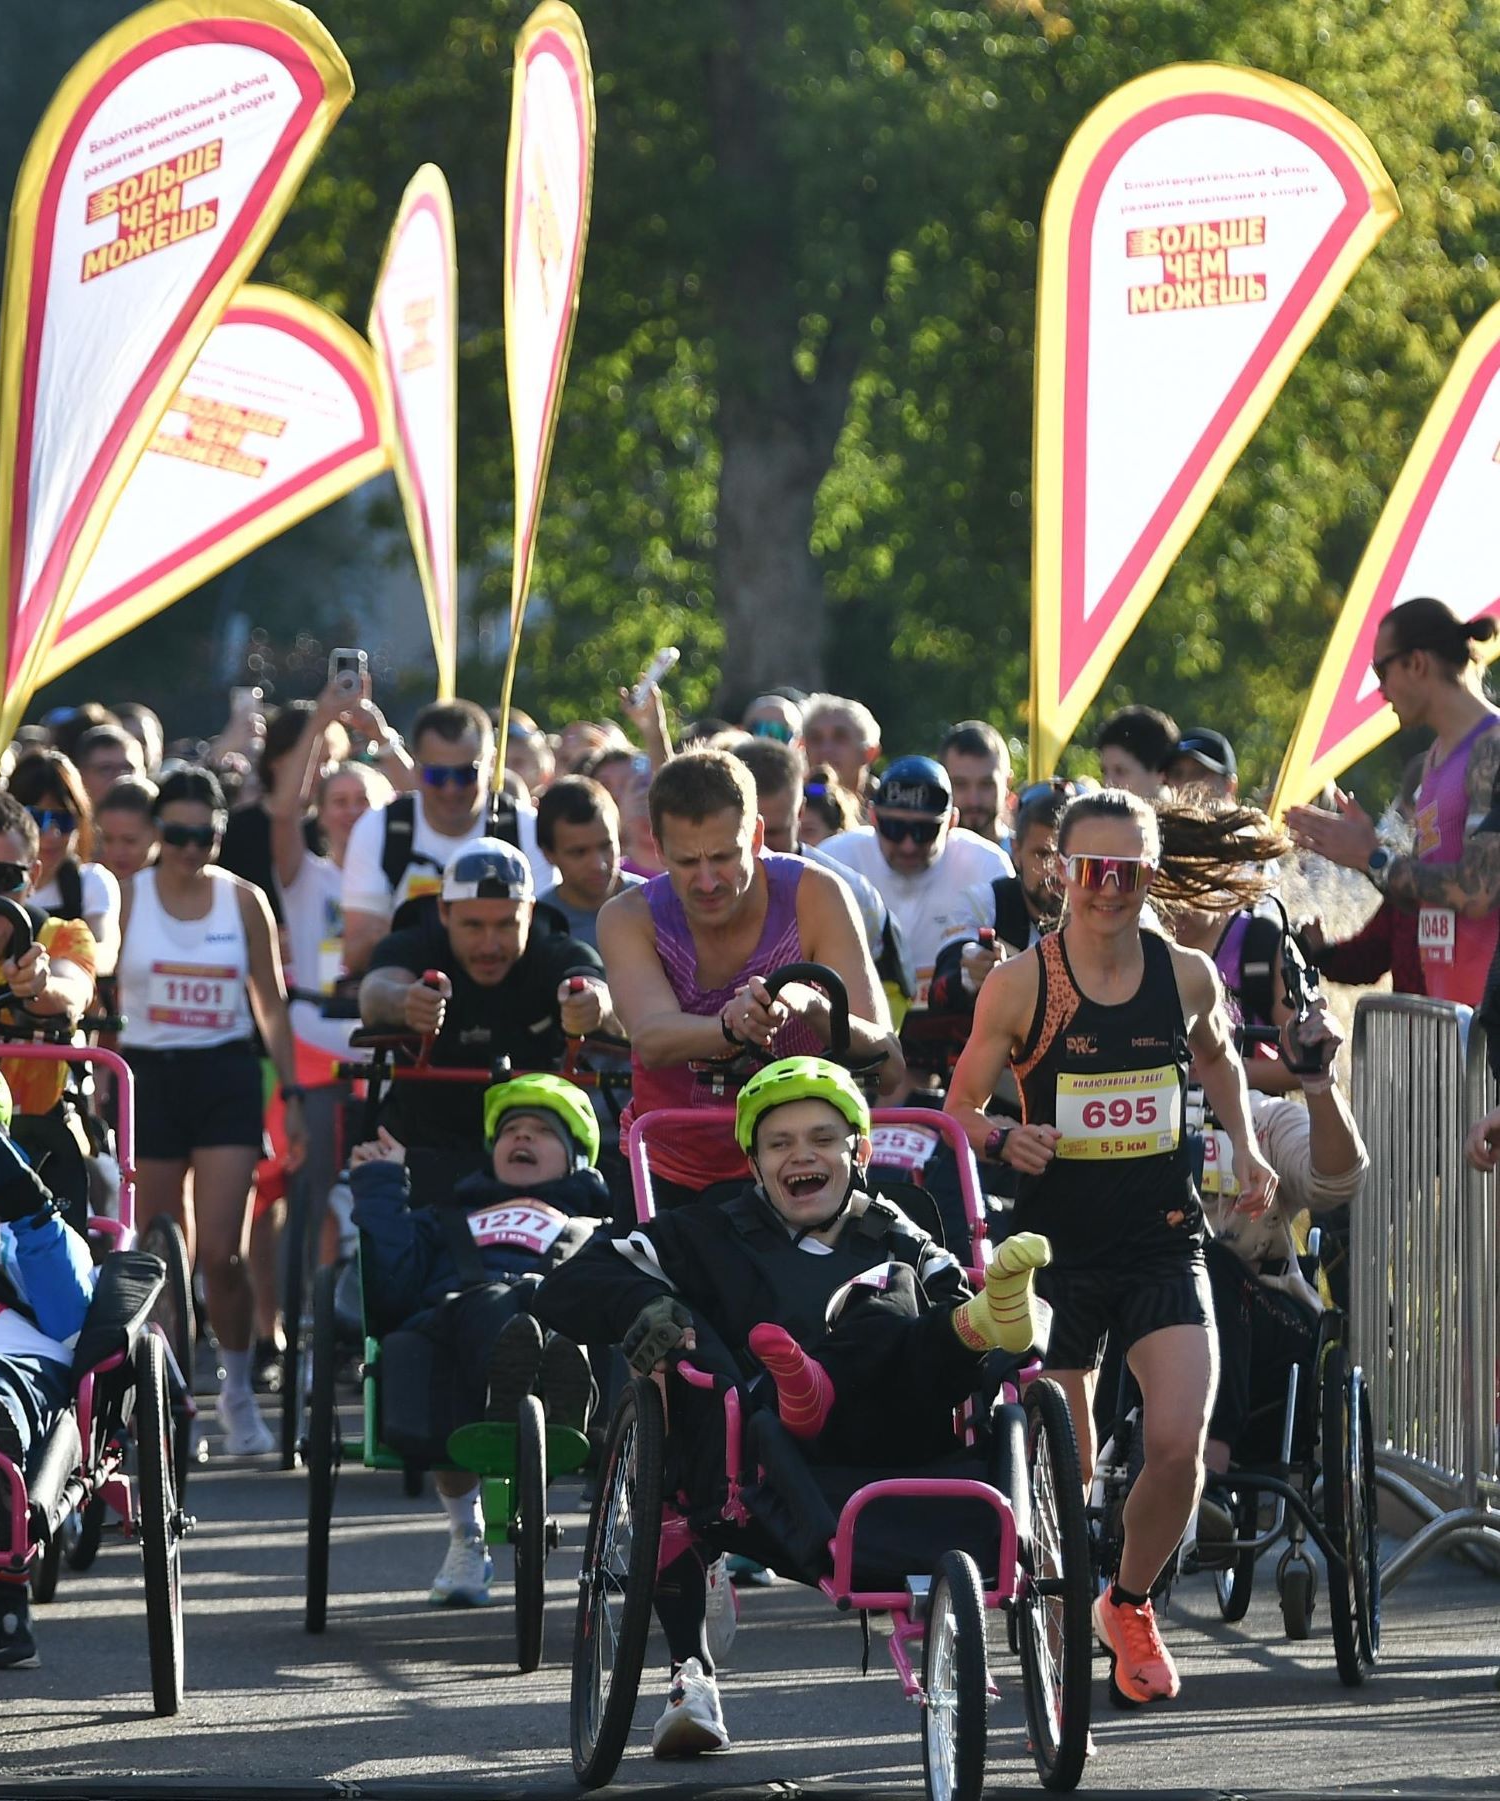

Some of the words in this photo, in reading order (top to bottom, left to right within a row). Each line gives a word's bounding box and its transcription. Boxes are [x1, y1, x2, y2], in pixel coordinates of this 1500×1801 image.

[88, 141, 221, 223] БОЛЬШЕ
[121, 186, 182, 231] ЧЕМ
[83, 204, 217, 281] МОЖЕШЬ
[1128, 217, 1264, 257] БОЛЬШЕ
[1164, 249, 1227, 280] ЧЕМ
[1128, 275, 1265, 313] МОЖЕШЬ
[1420, 914, 1449, 938] 1048
[166, 982, 223, 1003] 1101
[1072, 1075, 1137, 1089] ИНКЛЮЗИВНЫЙ
[1082, 1096, 1157, 1129] 695
[873, 1131, 926, 1153] 253
[1100, 1141, 1124, 1155] 5,5
[476, 1210, 551, 1232] 1277
